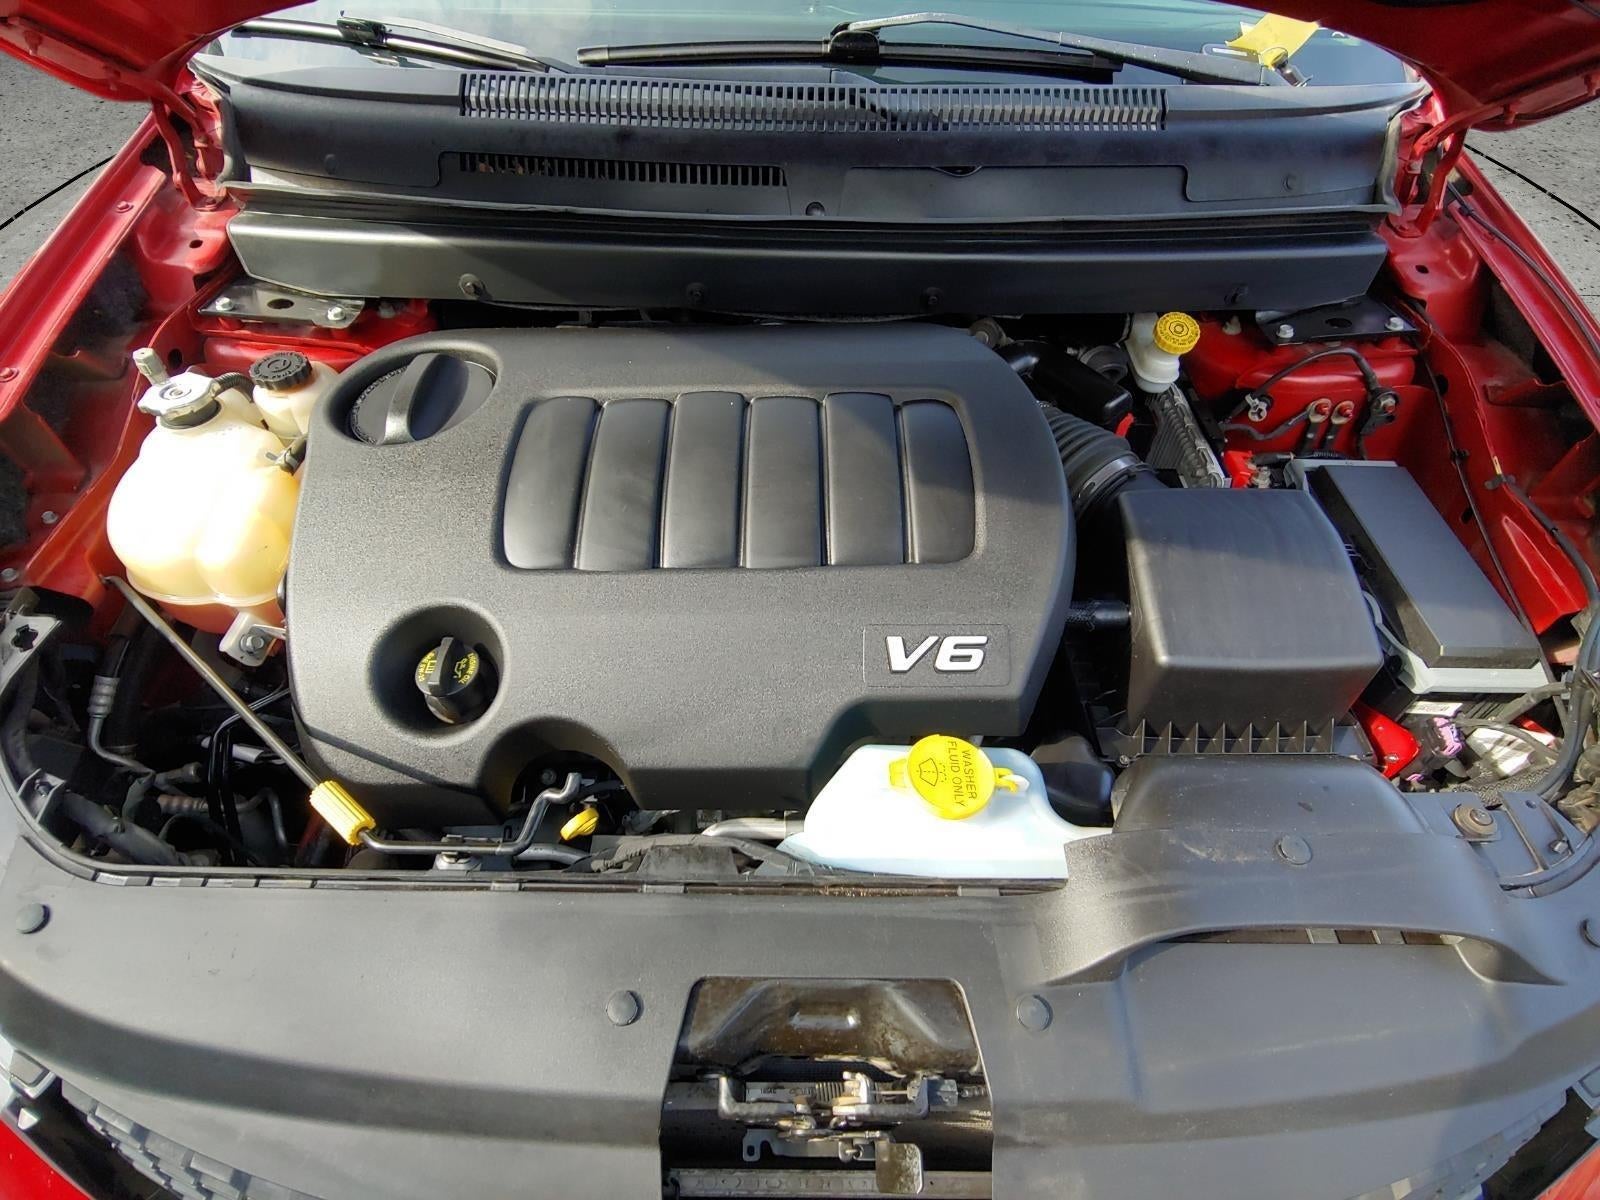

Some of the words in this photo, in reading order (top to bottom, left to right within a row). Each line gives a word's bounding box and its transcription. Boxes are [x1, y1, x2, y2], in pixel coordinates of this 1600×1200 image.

[886, 635, 988, 672] V6
[458, 674, 471, 684] OIL
[947, 740, 961, 773] FLUID
[961, 749, 978, 800] WASHER
[951, 776, 968, 808] ONLY
